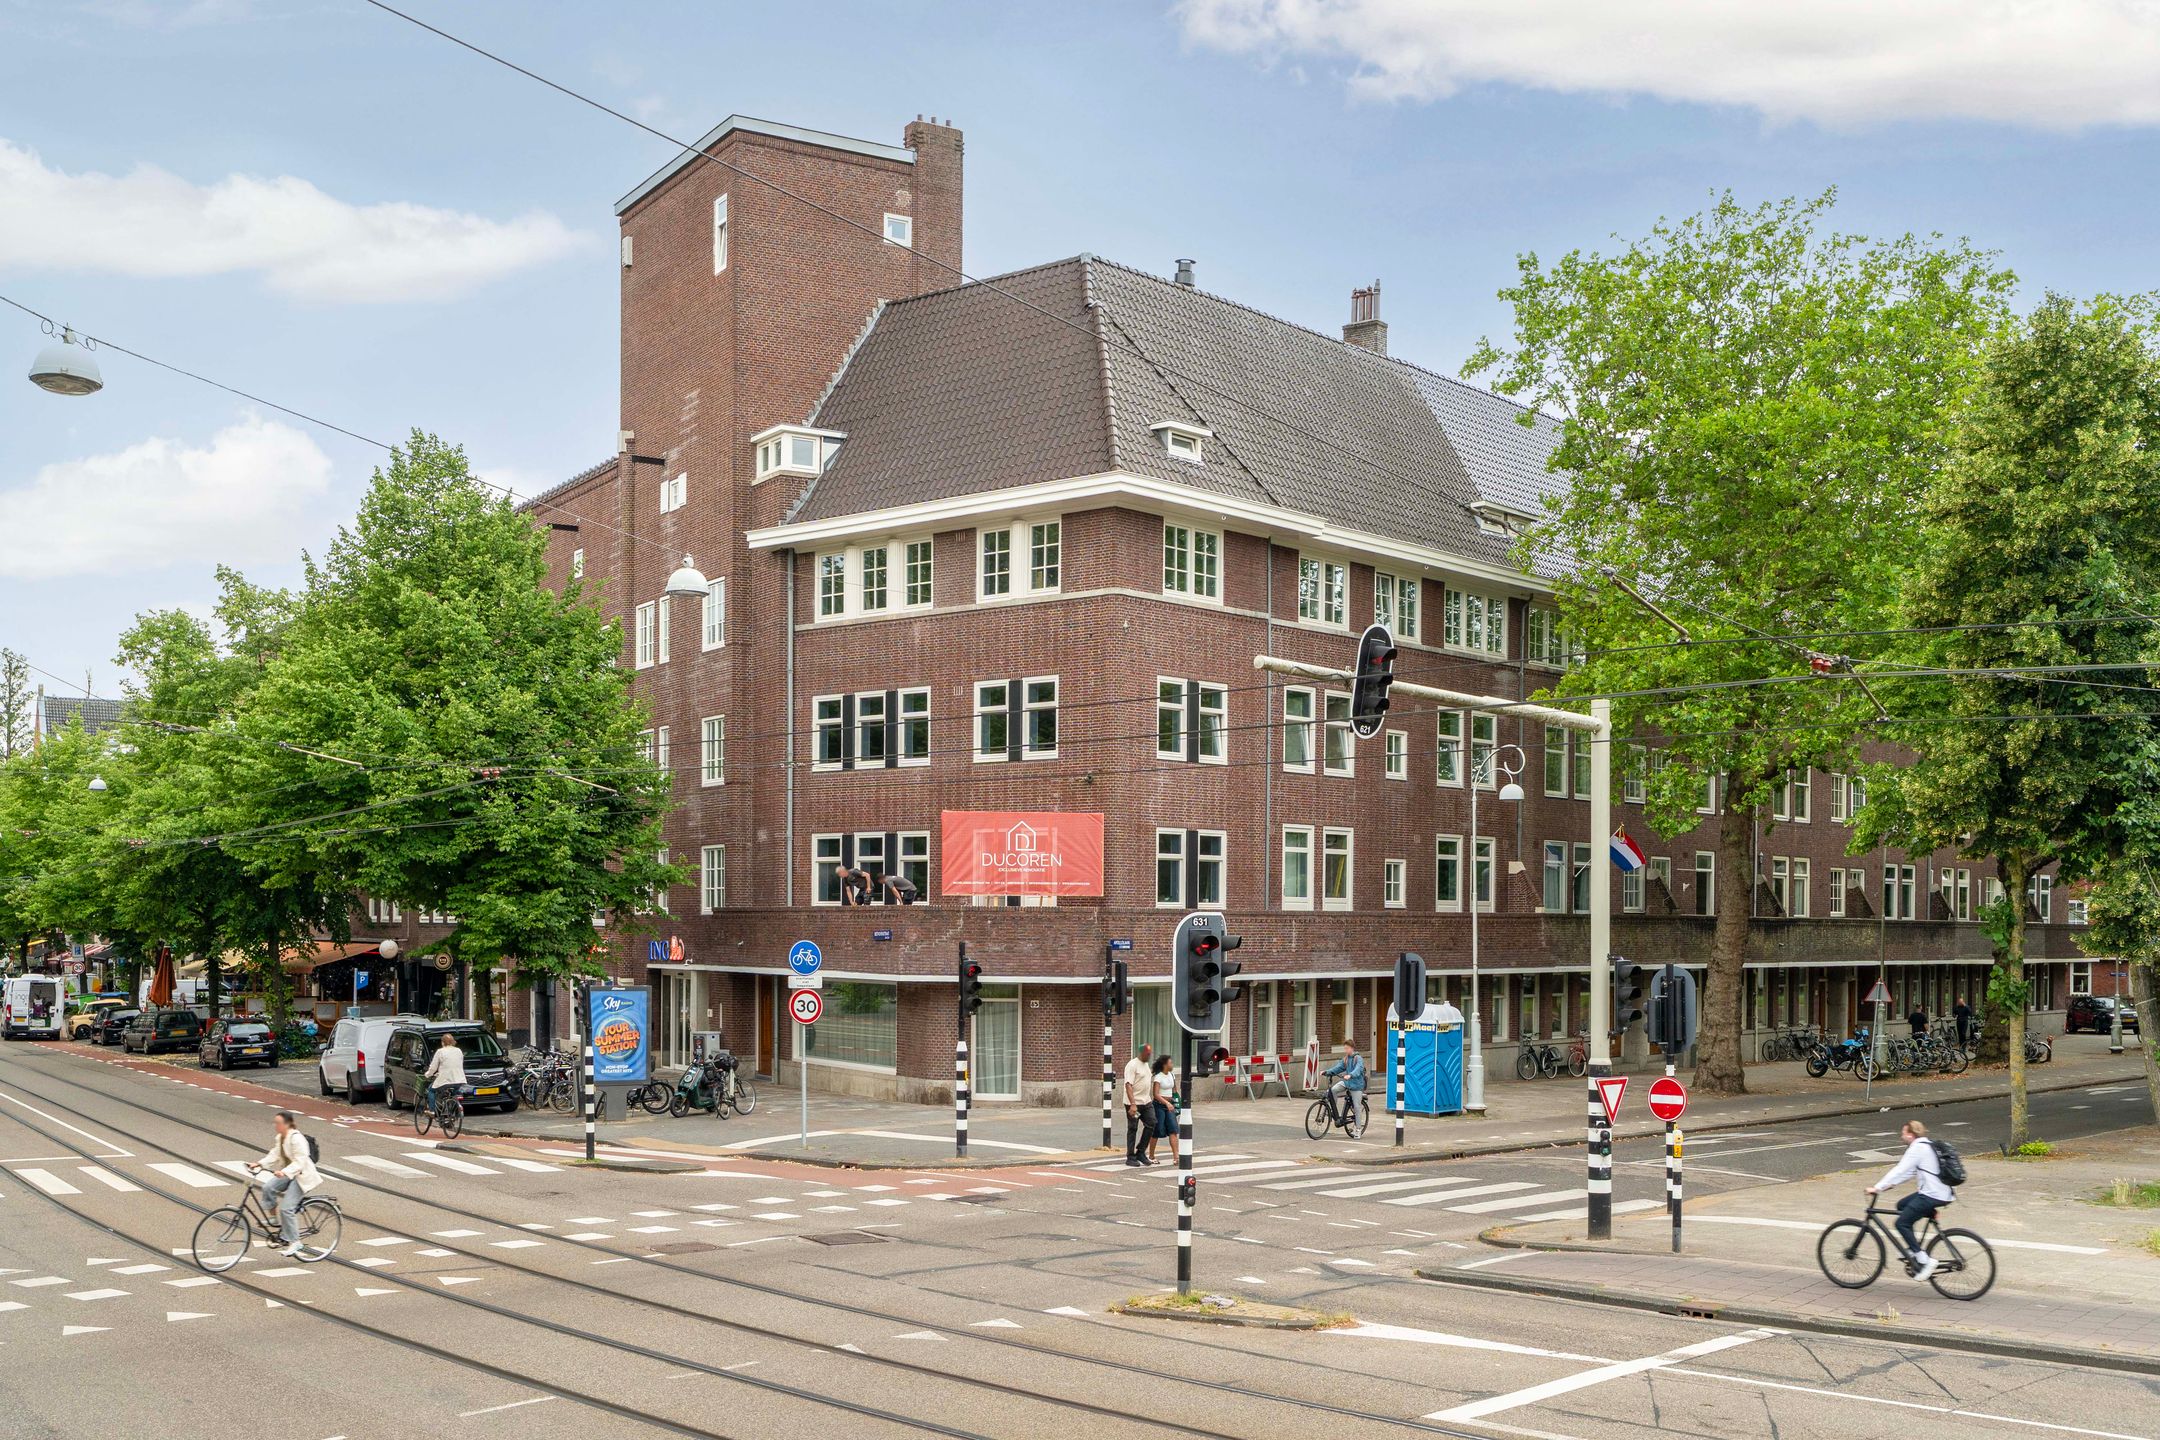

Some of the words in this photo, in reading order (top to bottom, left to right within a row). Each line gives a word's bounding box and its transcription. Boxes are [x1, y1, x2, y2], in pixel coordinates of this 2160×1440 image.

[982, 853, 1062, 867] DUCOREN
[1193, 917, 1208, 926] 631
[648, 940, 669, 960] ING
[604, 996, 620, 1011] Sky
[796, 999, 817, 1013] 30
[604, 1022, 630, 1036] YOUR
[1391, 1021, 1436, 1032] HurMaat
[594, 1030, 640, 1047] SUMMER
[599, 1040, 637, 1055] STATION
